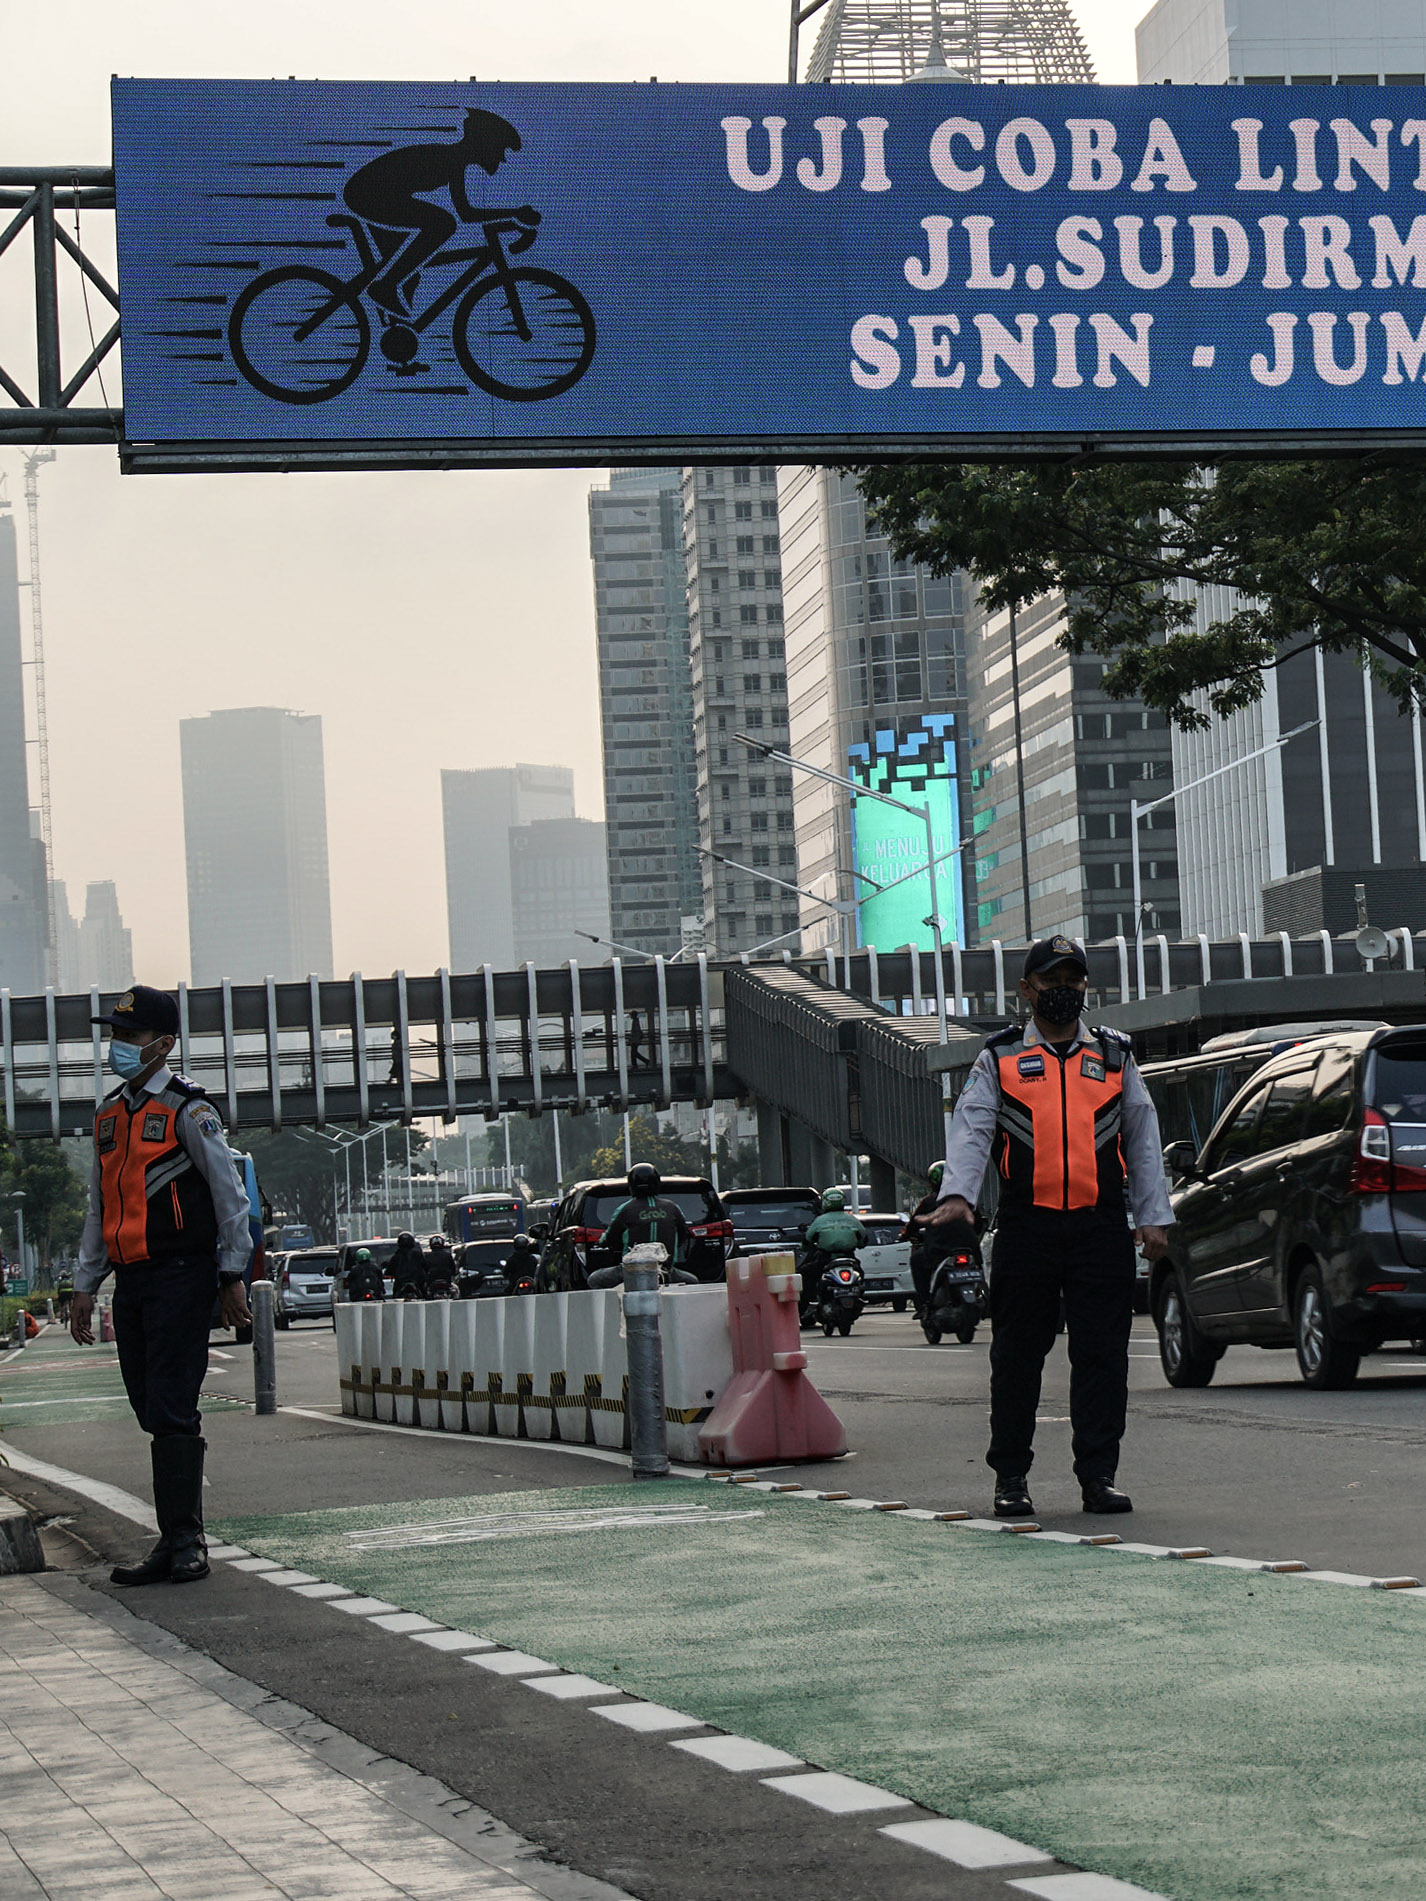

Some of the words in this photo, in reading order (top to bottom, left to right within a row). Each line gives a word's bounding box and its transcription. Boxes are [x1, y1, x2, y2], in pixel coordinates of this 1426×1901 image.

[720, 116, 892, 192] UJI
[929, 117, 1197, 192] COBA
[850, 312, 1154, 390] SENIN
[638, 1208, 668, 1221] Grab
